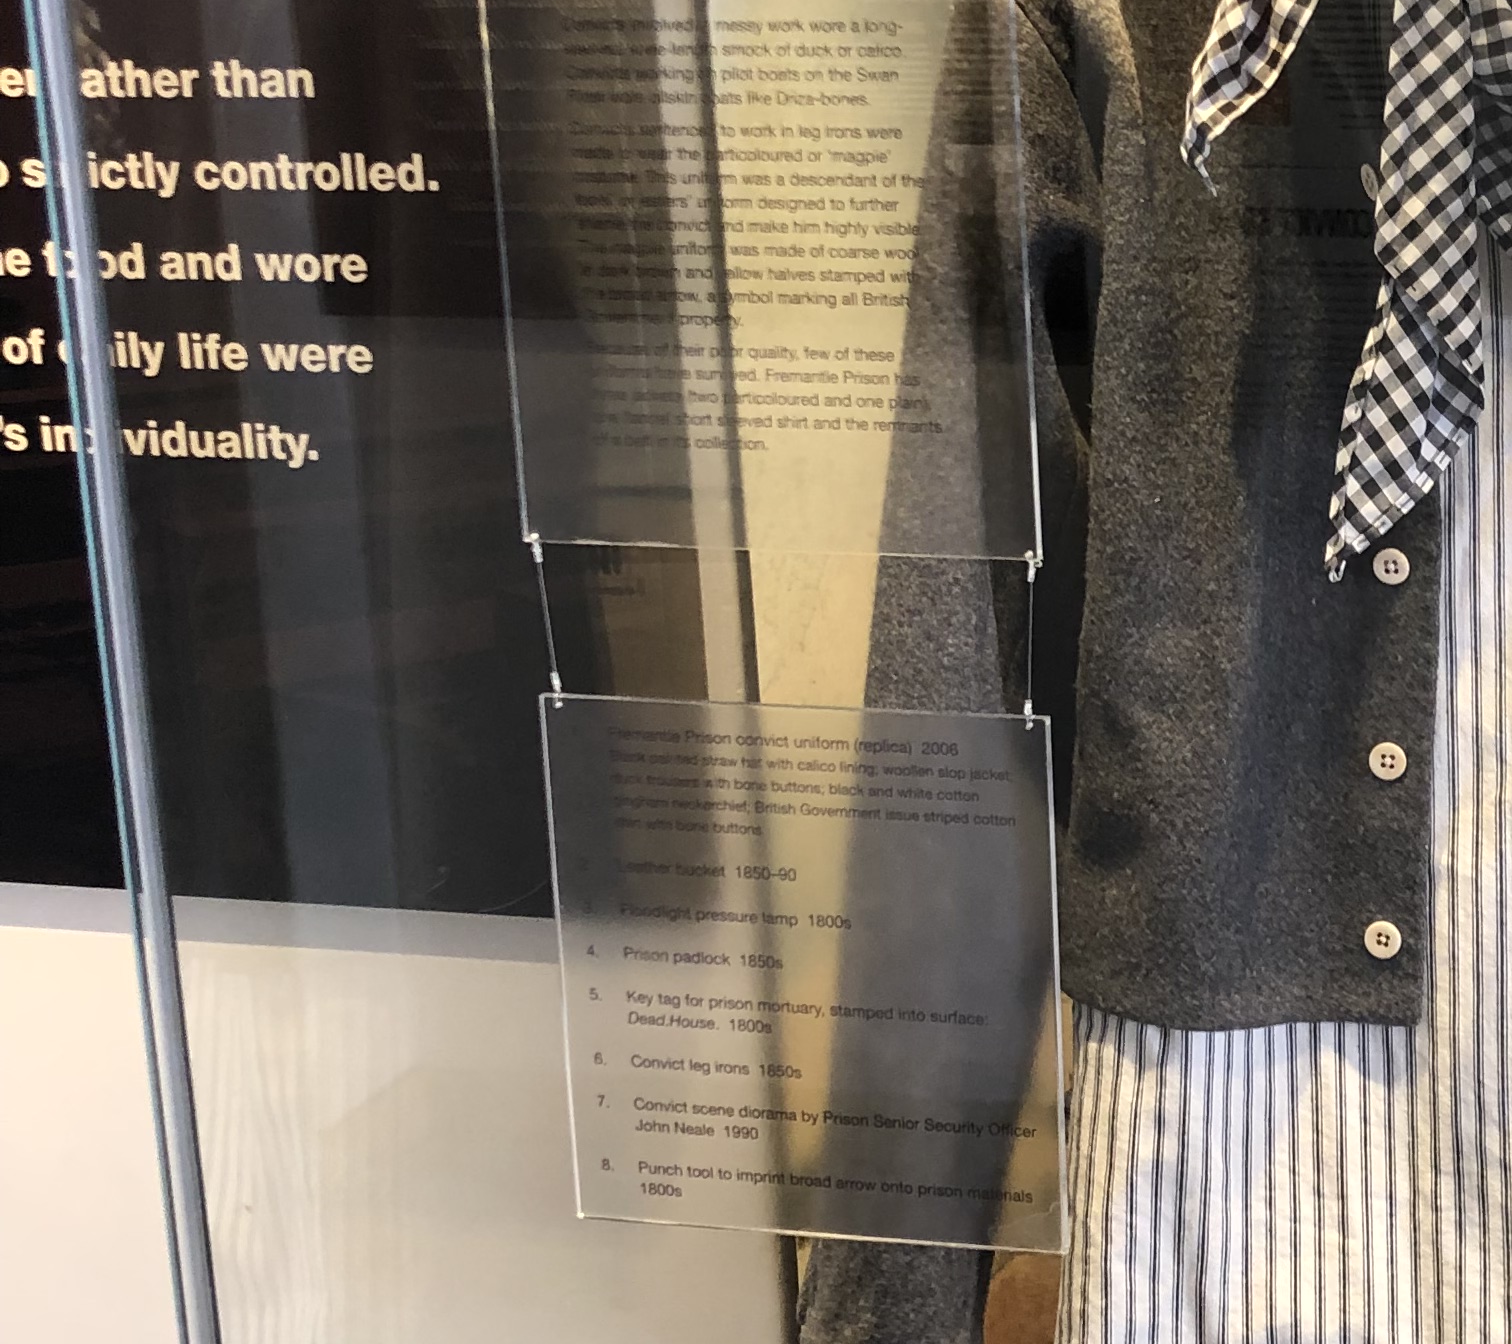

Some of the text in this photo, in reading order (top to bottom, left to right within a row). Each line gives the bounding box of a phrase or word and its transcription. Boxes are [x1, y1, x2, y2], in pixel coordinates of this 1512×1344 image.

[768, 18, 804, 33] work
[808, 20, 847, 33] wore
[80, 60, 201, 98] ather
[210, 59, 317, 99] than
[757, 67, 800, 82] boats
[828, 68, 852, 82] the
[740, 124, 777, 138] work
[866, 127, 903, 140] were
[23, 151, 440, 198] sictly controlled.
[743, 174, 772, 186] was
[790, 173, 877, 188] descendant
[758, 198, 826, 214] designed
[749, 221, 788, 234] make
[793, 221, 820, 234] him
[825, 221, 869, 238] highly
[764, 244, 806, 257] made
[829, 247, 880, 258] coarse
[160, 243, 243, 283] and
[254, 251, 369, 284] wore
[820, 268, 885, 286] stamped
[2, 328, 375, 378] of ily life were
[748, 345, 799, 362] quality,
[803, 345, 831, 361] few
[854, 346, 895, 362] these
[843, 369, 890, 385] Prison
[824, 394, 852, 408] and
[856, 396, 884, 409] one
[813, 416, 841, 430] and
[845, 416, 869, 431] the
[38, 415, 320, 469] inviduality.
[736, 735, 789, 749] convict
[793, 737, 850, 751] uniform
[854, 737, 913, 755] (replica)
[797, 760, 836, 773] calico
[829, 783, 980, 802] black and white cotton
[754, 801, 796, 815] British
[800, 803, 881, 820] Government
[924, 812, 969, 827] striped
[973, 815, 1017, 827] cotton
[695, 909, 758, 925] pressure
[762, 911, 798, 928] lamp
[808, 914, 852, 930] 1800s
[586, 944, 784, 970] 4. Prison padlock 1850s
[588, 987, 989, 1027] 5. Key tag for prison mortuary, stamped into surface:
[729, 1018, 773, 1035] 1800s
[593, 1051, 803, 1080] 6. Convict leg irons 1850s
[596, 1094, 1037, 1139] 7. Convict scene diorama by Prison Senior Security Officer
[635, 1119, 759, 1141] John Neale 1990
[601, 1158, 615, 1173] 8.
[638, 1160, 683, 1177] Punch
[687, 1165, 713, 1180] tool
[718, 1167, 733, 1181] to
[737, 1167, 785, 1186] imprint
[790, 1172, 832, 1188] broad
[835, 1178, 877, 1192] arrow
[880, 1180, 913, 1195] onto
[917, 1183, 963, 1200] prison
[640, 1182, 683, 1199] 1800s
